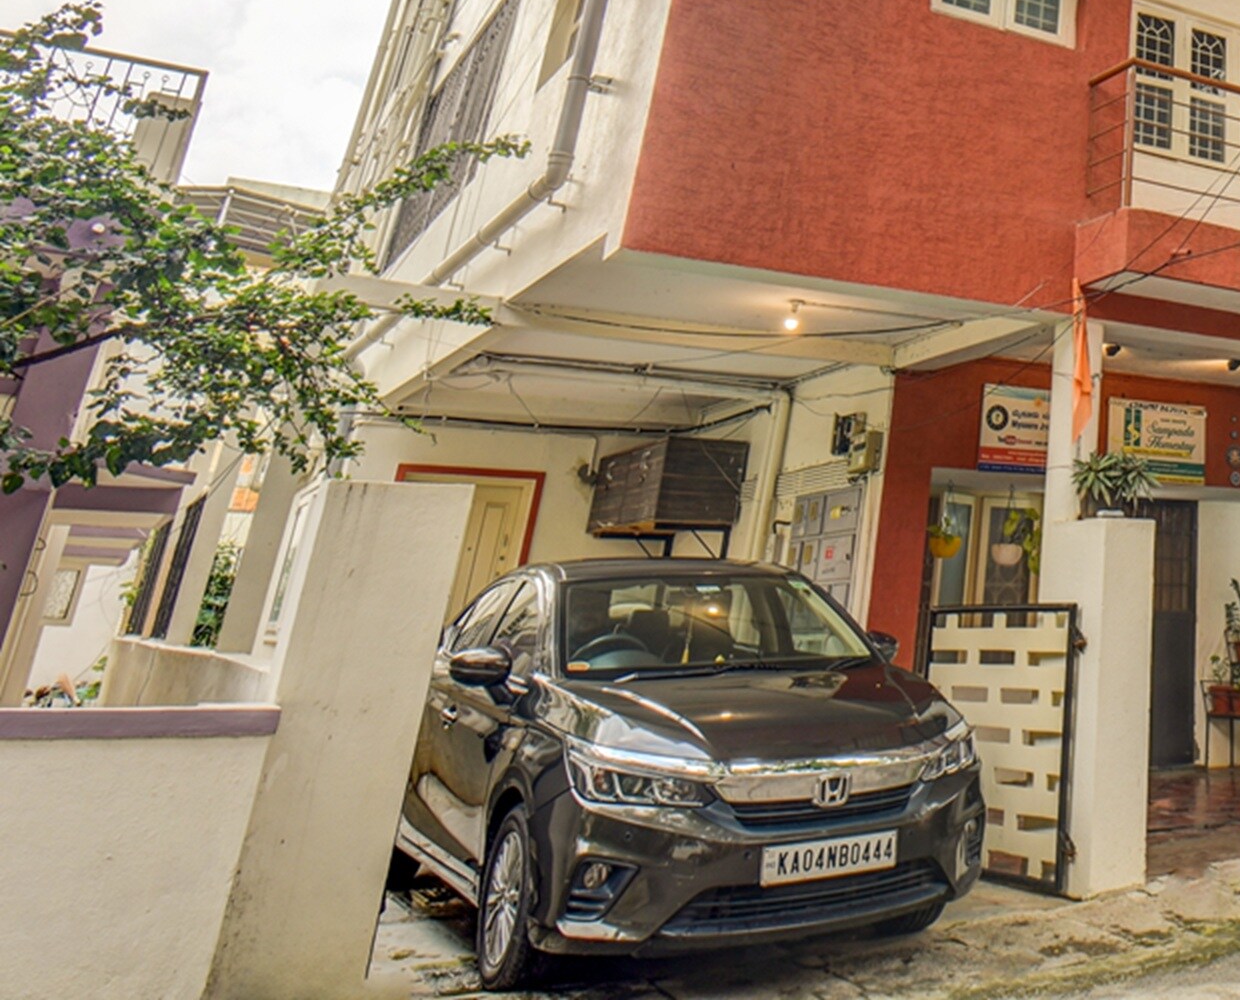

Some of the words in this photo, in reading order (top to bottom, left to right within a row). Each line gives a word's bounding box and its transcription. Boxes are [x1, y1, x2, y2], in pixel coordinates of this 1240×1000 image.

[1146, 420, 1195, 439] Sampada
[1145, 436, 1196, 455] Homestay
[777, 837, 893, 876] KA04NB0444
